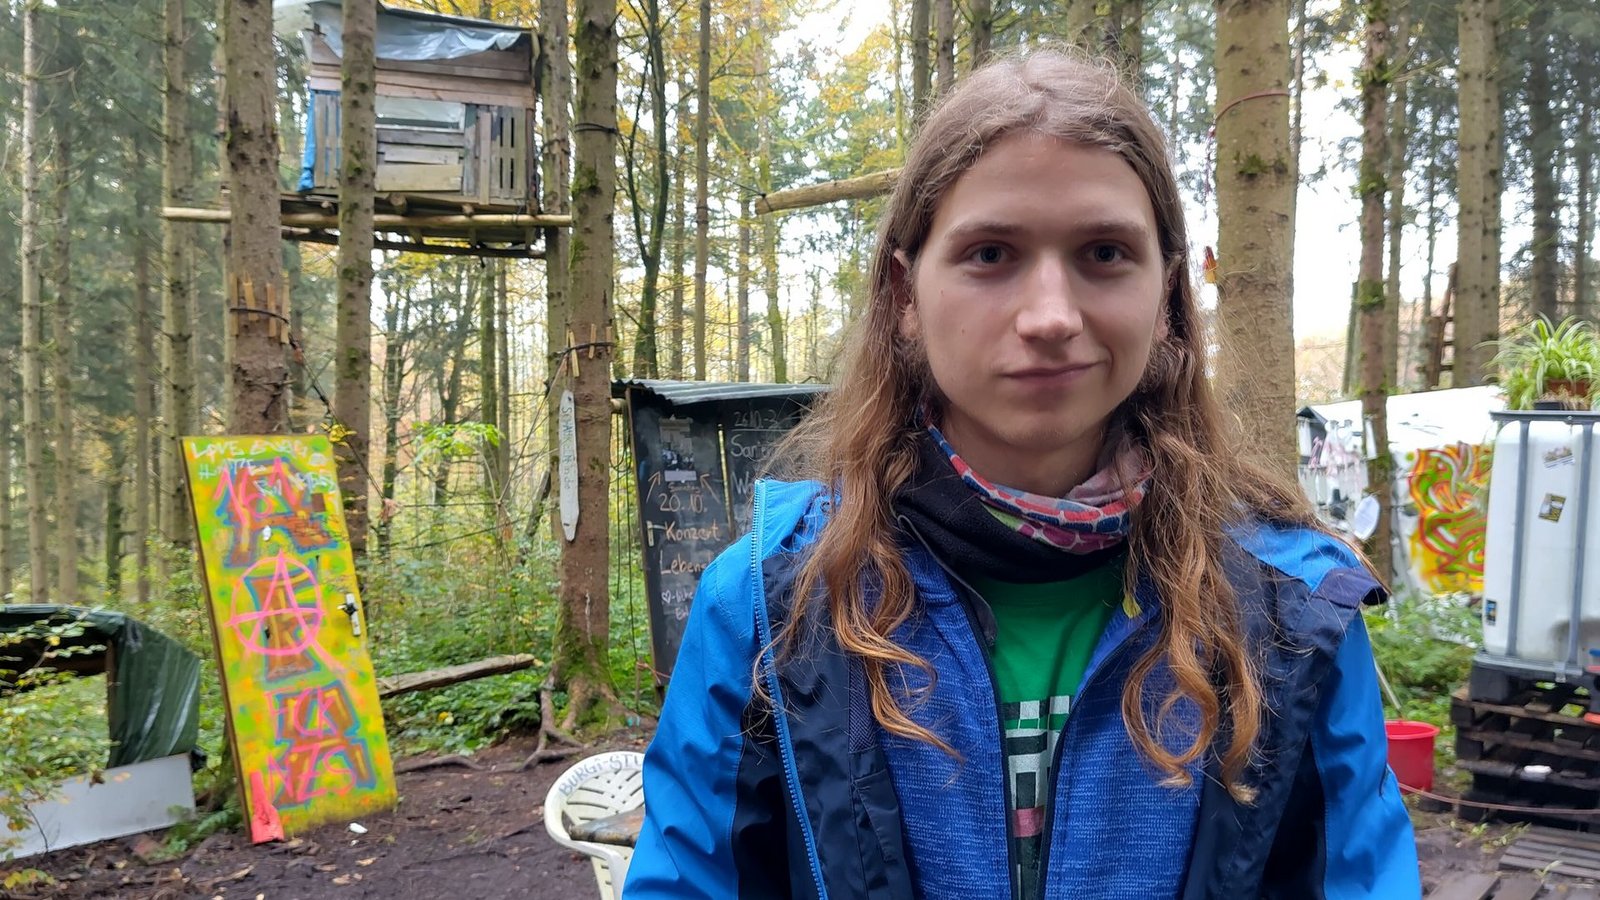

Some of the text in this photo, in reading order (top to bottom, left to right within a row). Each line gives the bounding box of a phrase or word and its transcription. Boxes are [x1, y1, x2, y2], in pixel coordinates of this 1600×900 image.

[665, 519, 721, 541] Konzert
[264, 684, 338, 740] FCK
[267, 743, 357, 804] NZS
